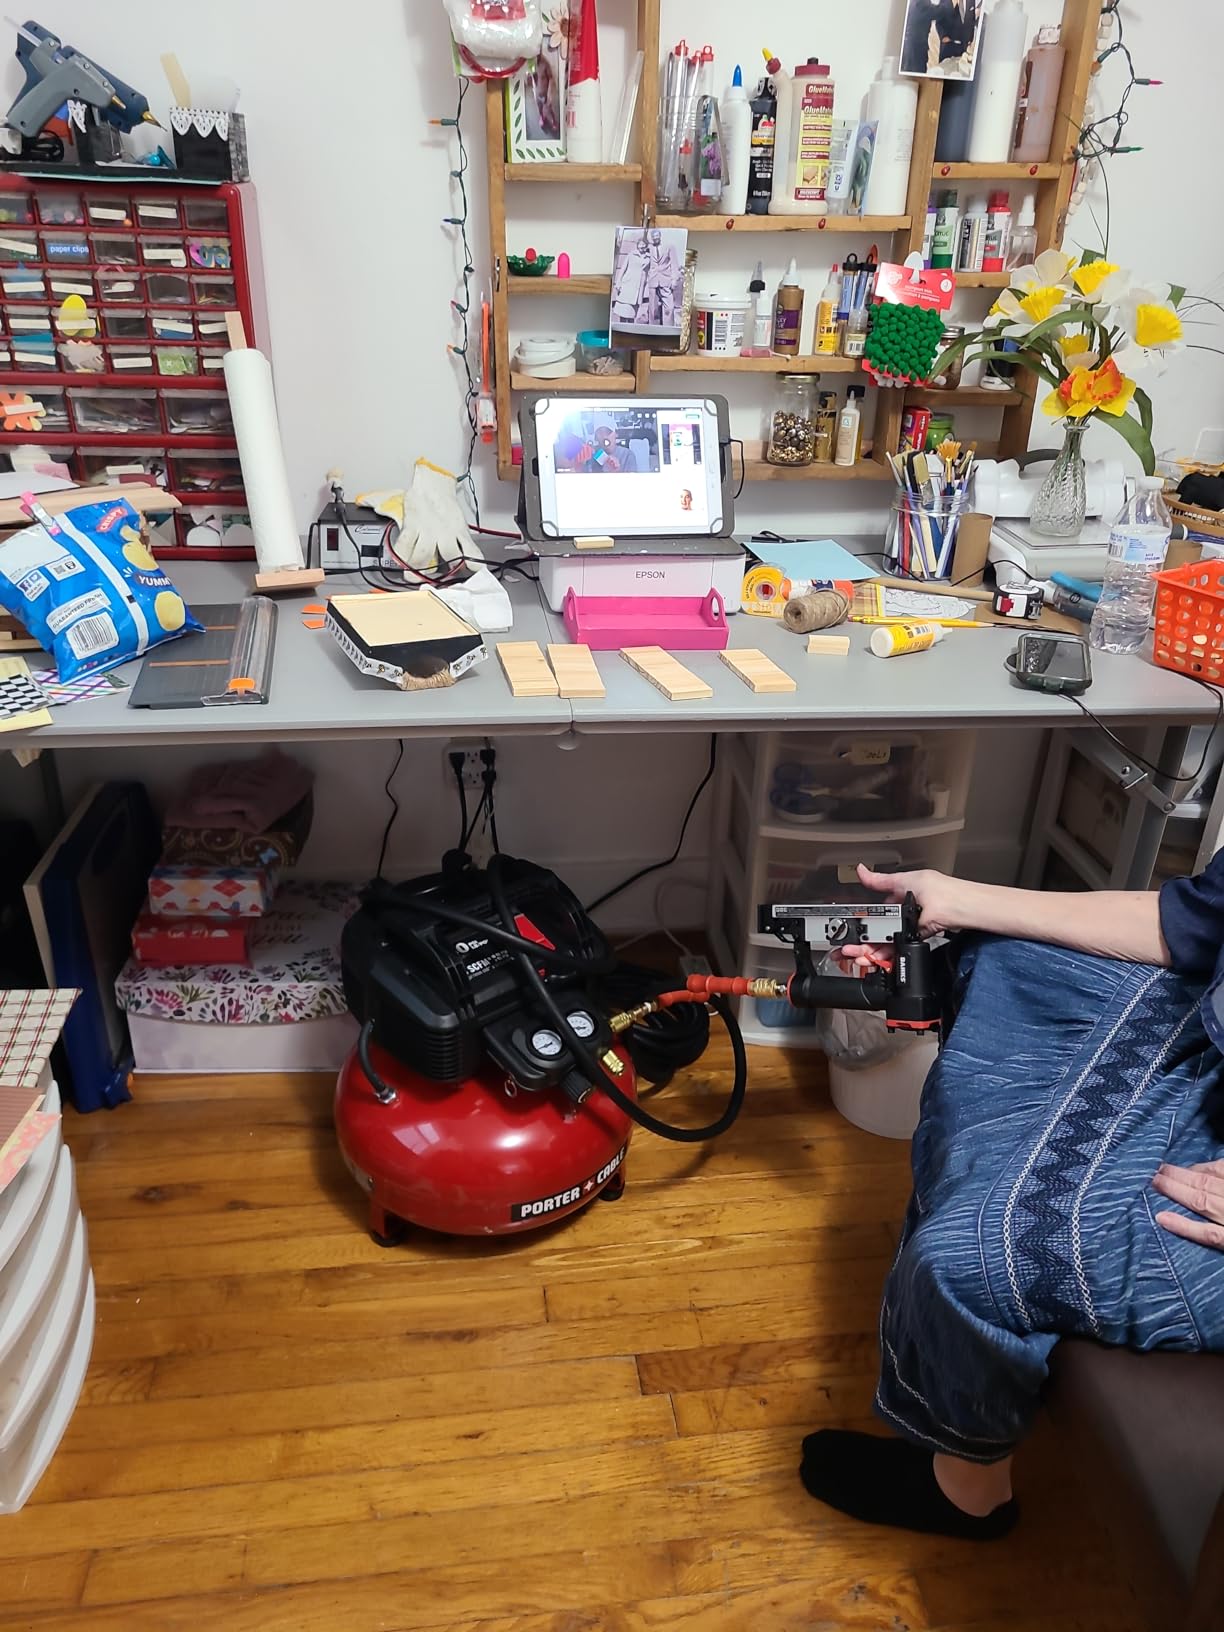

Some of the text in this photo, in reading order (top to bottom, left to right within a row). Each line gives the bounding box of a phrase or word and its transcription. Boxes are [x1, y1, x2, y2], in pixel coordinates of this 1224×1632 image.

[50, 246, 70, 254] paper
[635, 571, 666, 579] EPSON
[596, 1147, 625, 1184] CABLE
[521, 1186, 580, 1218] PORTER
